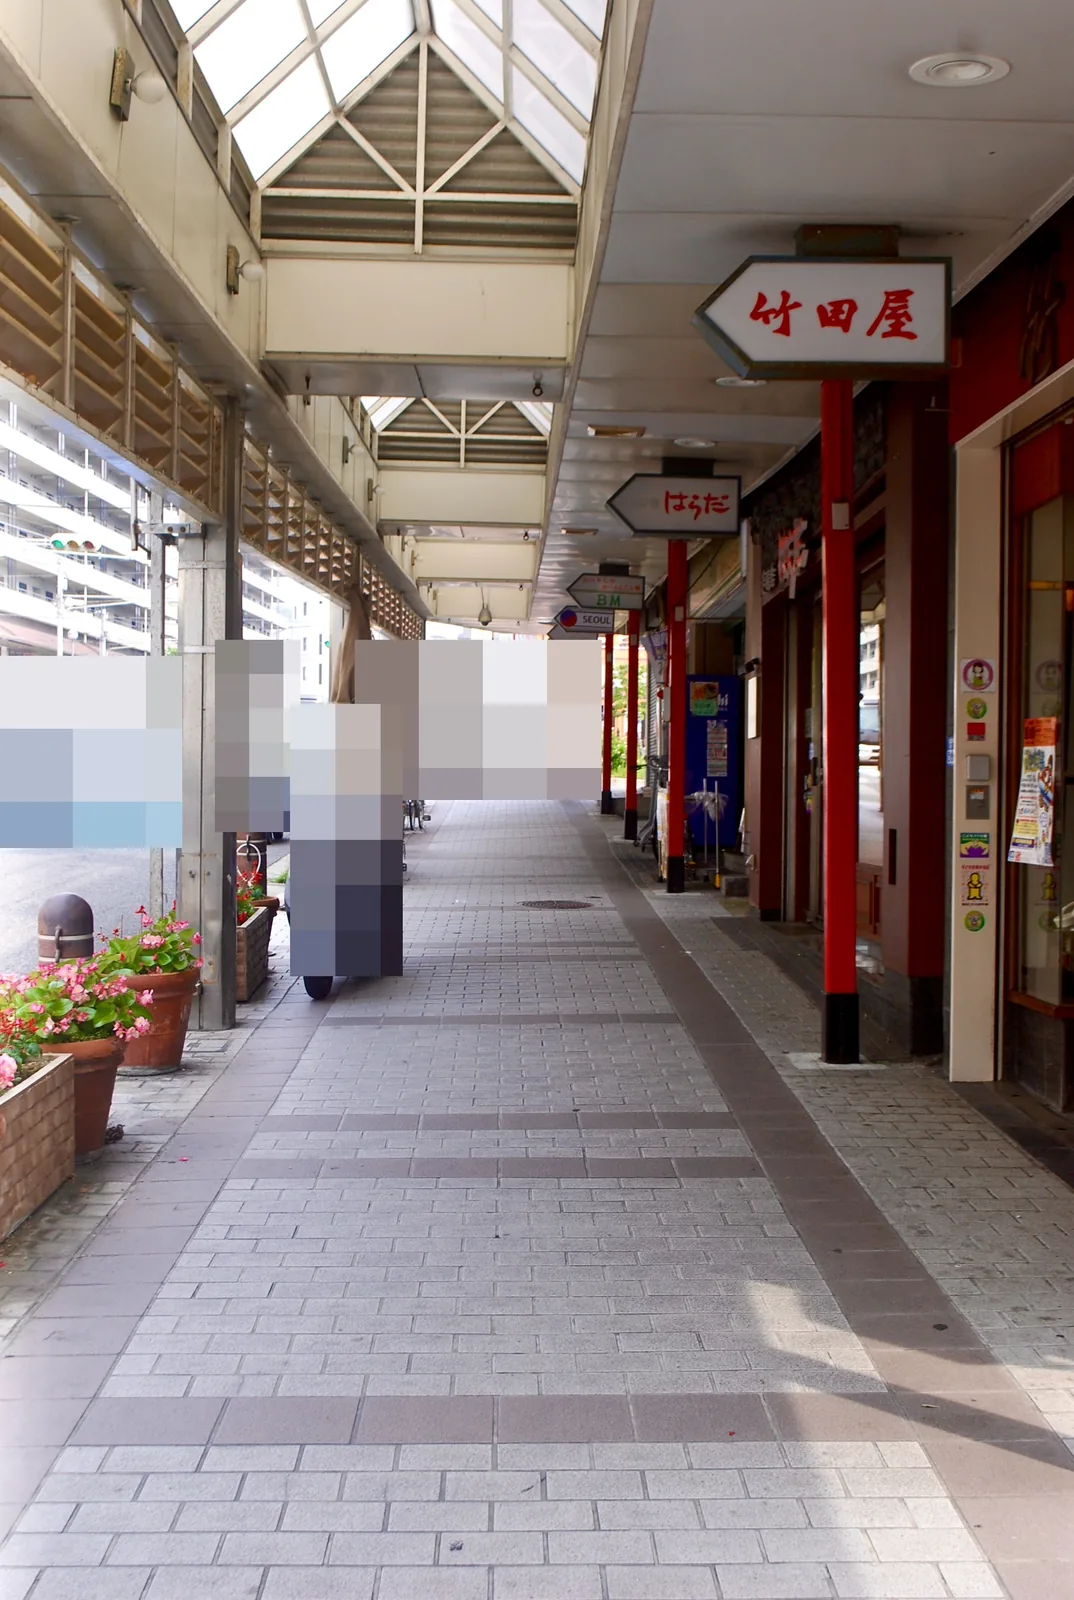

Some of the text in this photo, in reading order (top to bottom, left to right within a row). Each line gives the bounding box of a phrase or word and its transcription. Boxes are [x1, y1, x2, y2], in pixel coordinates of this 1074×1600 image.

[749, 288, 918, 341] 竹田屋
[664, 490, 731, 520] はらだ
[582, 615, 611, 624] SEOUL
